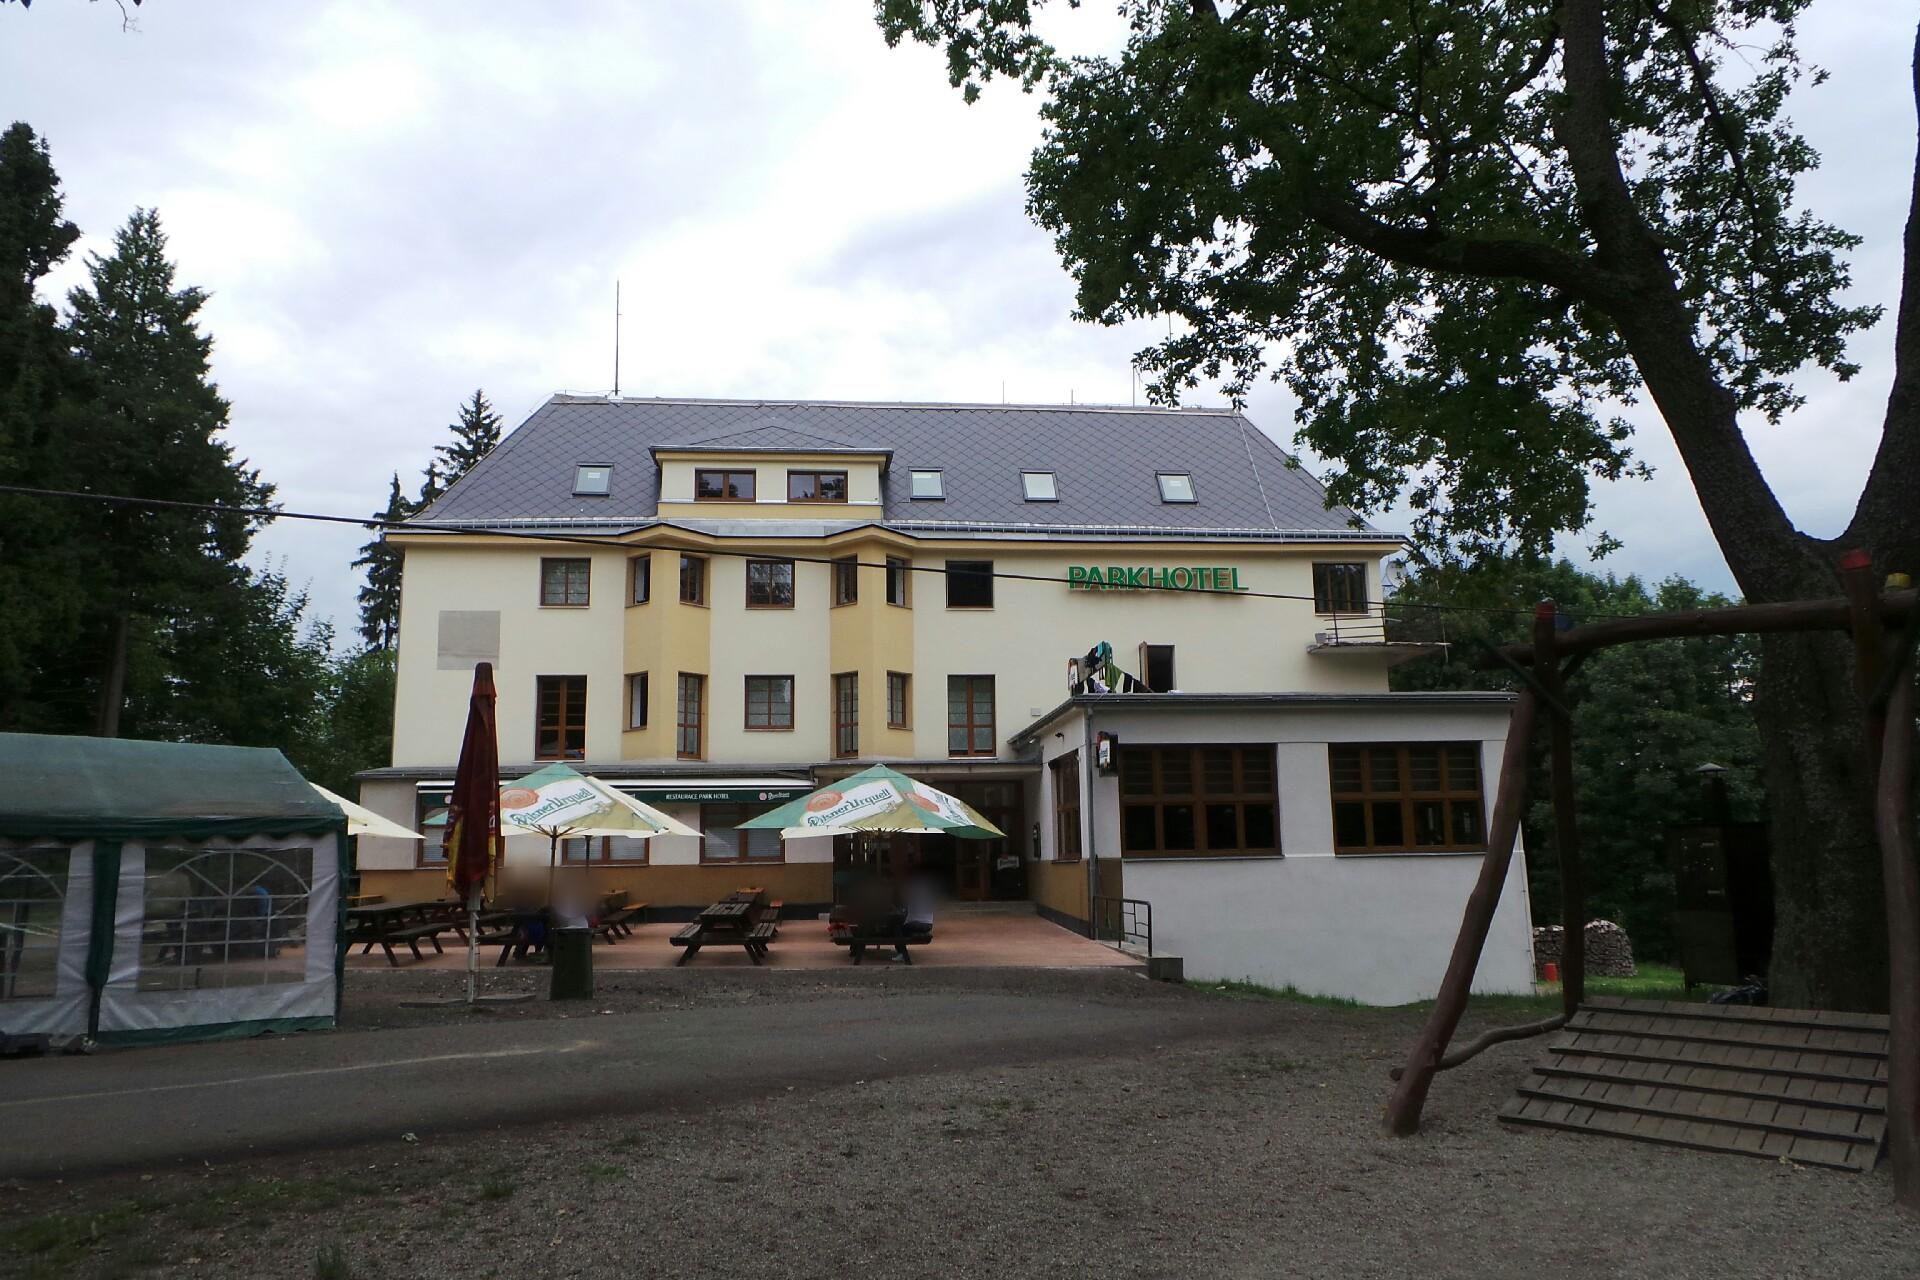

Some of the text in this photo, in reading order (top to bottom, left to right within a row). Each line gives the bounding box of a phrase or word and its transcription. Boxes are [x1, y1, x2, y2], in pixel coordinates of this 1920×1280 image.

[1067, 565, 1249, 592] PARKHOTEL
[546, 787, 594, 809] Urquell
[698, 792, 713, 800] PARK
[713, 792, 729, 800] HOTEL
[846, 788, 891, 809] Urquell
